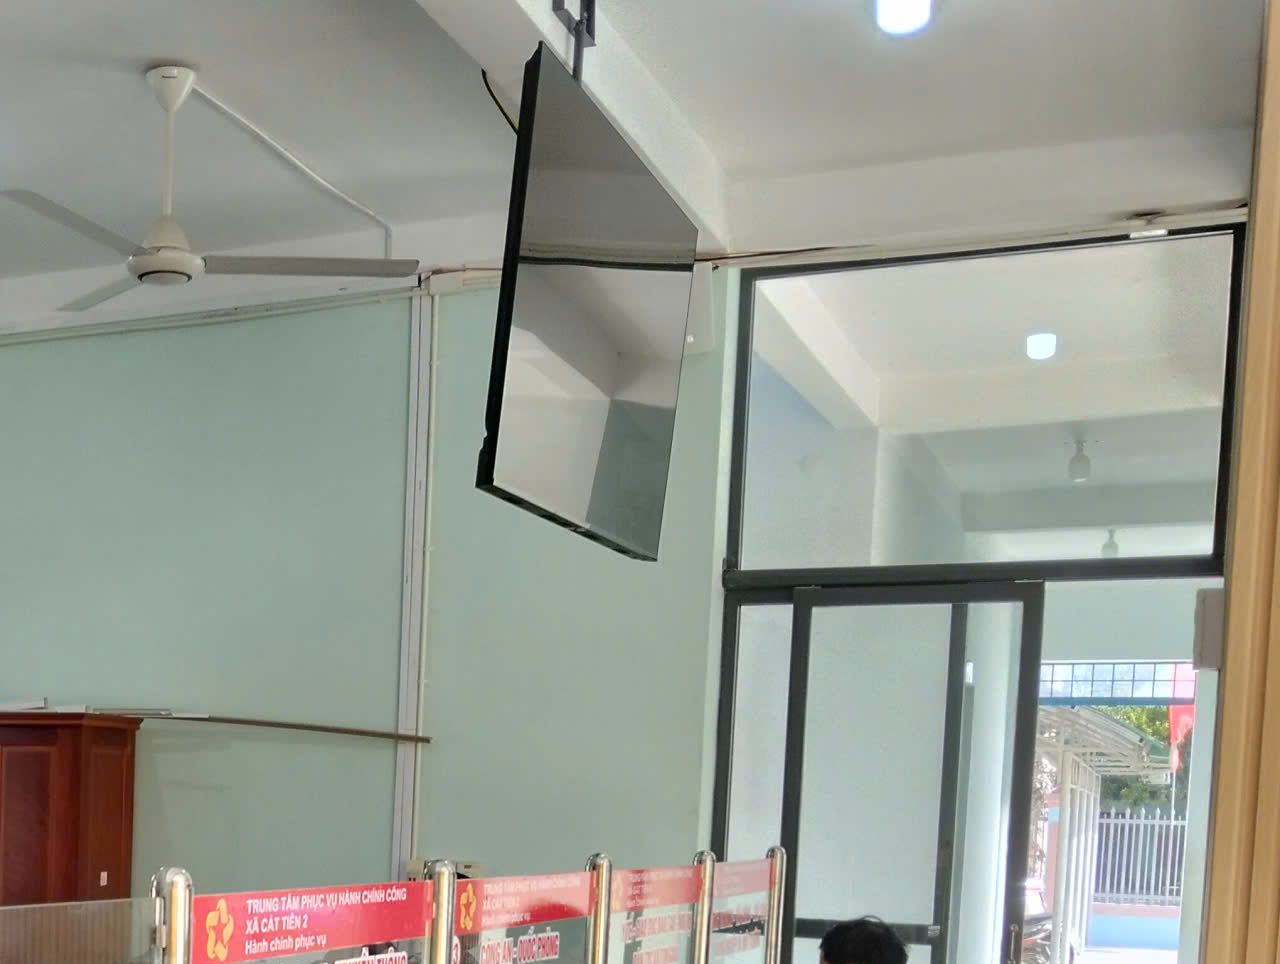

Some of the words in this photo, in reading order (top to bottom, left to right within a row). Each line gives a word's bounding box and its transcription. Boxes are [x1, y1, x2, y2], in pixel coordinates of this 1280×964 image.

[246, 897, 279, 915] TRUNG
[281, 893, 299, 911] TÂM
[301, 894, 324, 912] PHỤC
[326, 893, 337, 910] VỤ
[338, 889, 360, 905] HÀNH
[361, 887, 385, 904] CHÍNH
[385, 885, 407, 903] CÔNG
[245, 916, 260, 935] XÃ
[261, 914, 280, 933] CÁT
[302, 914, 308, 929] 2
[245, 938, 268, 955] Hành
[270, 936, 294, 952] chính
[295, 934, 315, 952] phục
[316, 934, 327, 948] vụ
